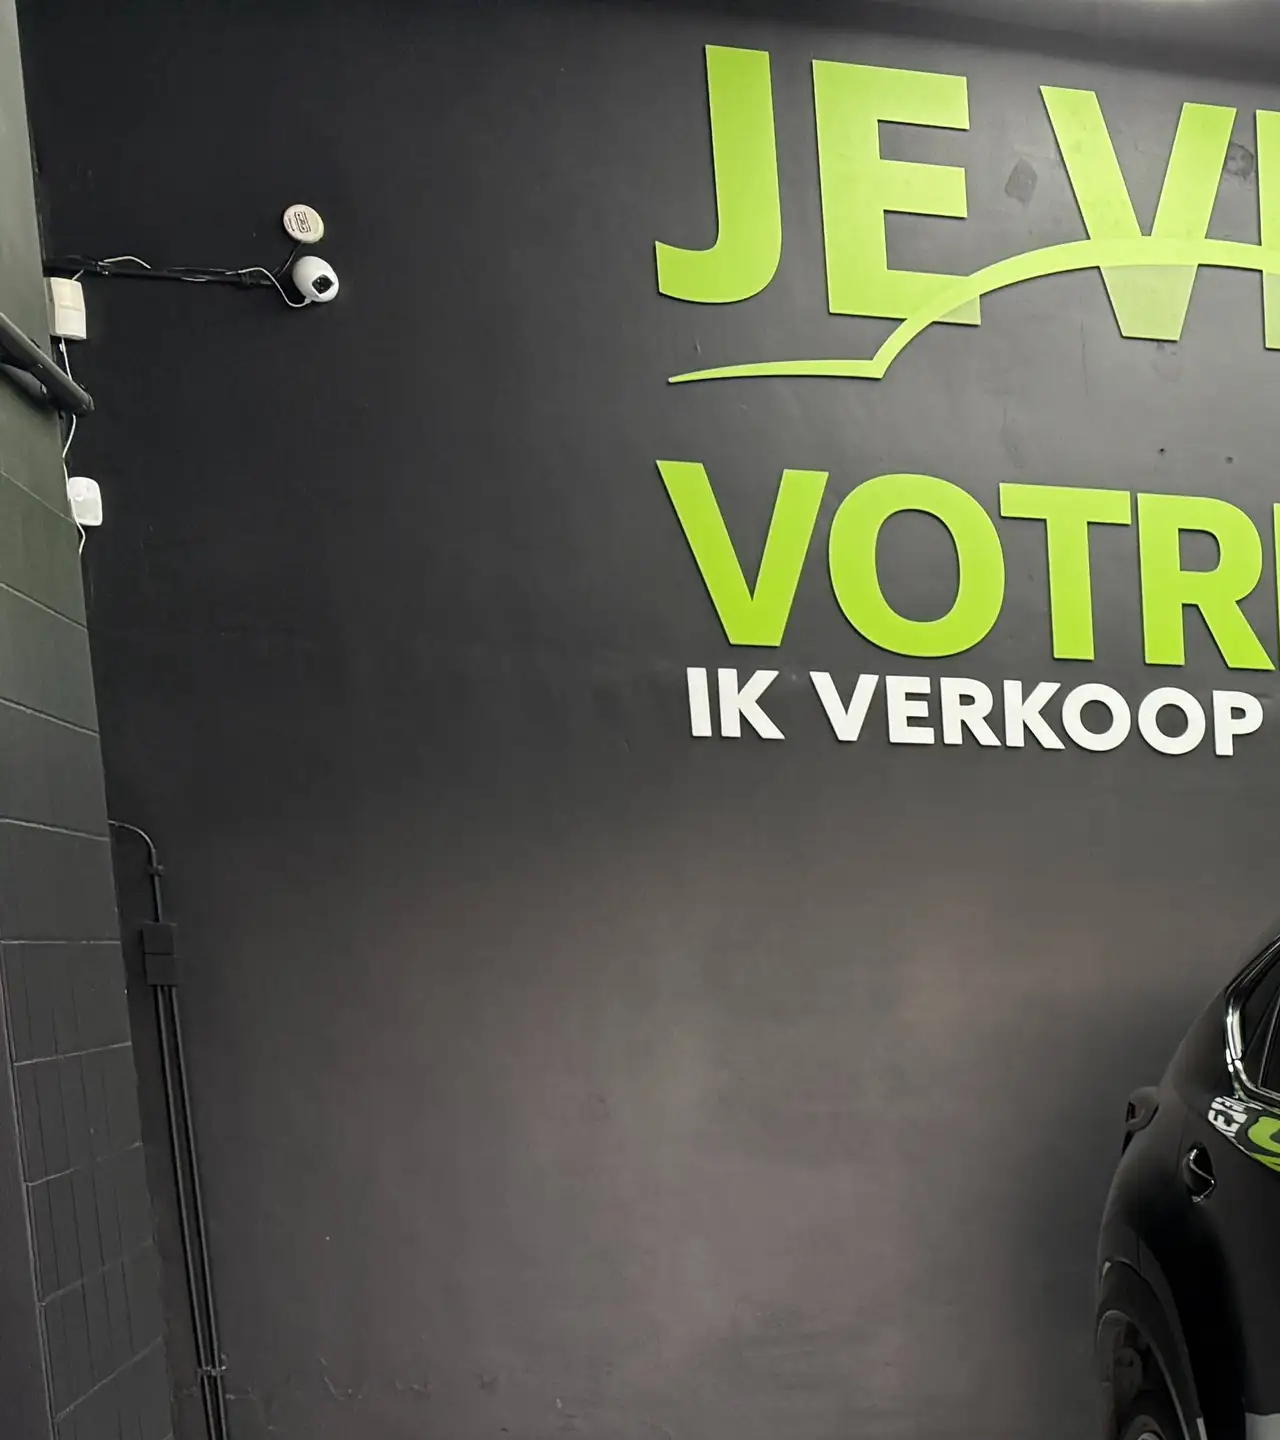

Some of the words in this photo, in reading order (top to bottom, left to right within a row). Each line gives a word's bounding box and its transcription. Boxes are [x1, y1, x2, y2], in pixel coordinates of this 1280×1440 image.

[656, 45, 981, 326] JE
[687, 667, 785, 740] IK
[810, 671, 1264, 756] VERKOOP
